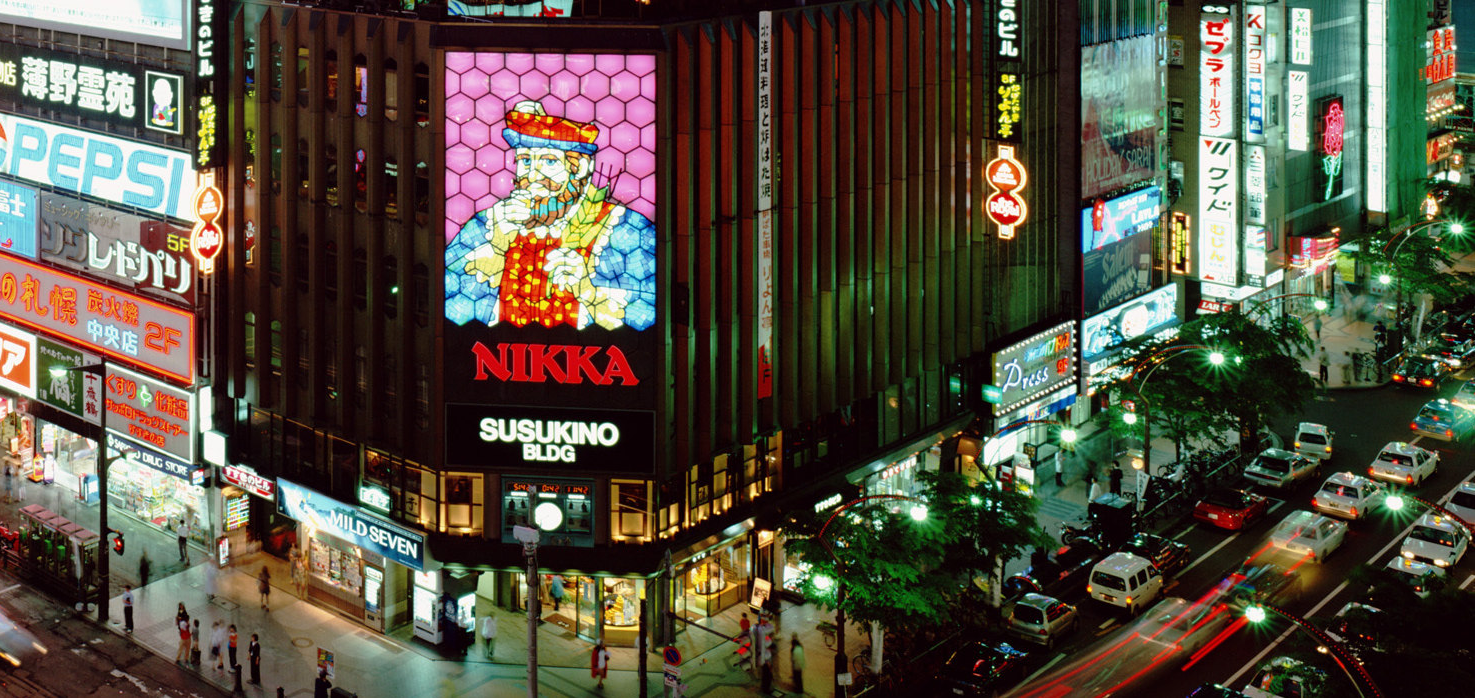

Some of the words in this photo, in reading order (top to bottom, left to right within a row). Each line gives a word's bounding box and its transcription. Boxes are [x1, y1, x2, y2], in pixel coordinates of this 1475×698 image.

[198, 0, 215, 77] きのビル
[1205, 17, 1230, 73] ゼブラ
[1248, 34, 1262, 75] コクヨ
[1250, 81, 1262, 131] 事務用品
[8, 121, 186, 218] PEPSI
[1206, 166, 1232, 212] ワイド
[166, 233, 190, 252] 5F
[1210, 223, 1225, 263] むじん
[87, 288, 140, 327] 炭火焼
[86, 318, 139, 356] 中央店
[144, 321, 182, 355] 2F
[471, 341, 640, 387] NIKKA
[1002, 358, 1049, 392] Dress
[105, 373, 137, 400] くすり
[154, 390, 189, 422] 化粧品
[128, 423, 166, 448] すすきの店
[479, 417, 620, 447] SUSUKINO
[142, 452, 163, 468] DRUG
[165, 460, 189, 477] STORE
[522, 443, 576, 463] BLDG
[225, 465, 271, 491] すすきのビル
[328, 509, 368, 538] MILD
[368, 525, 418, 560] SEVEN
